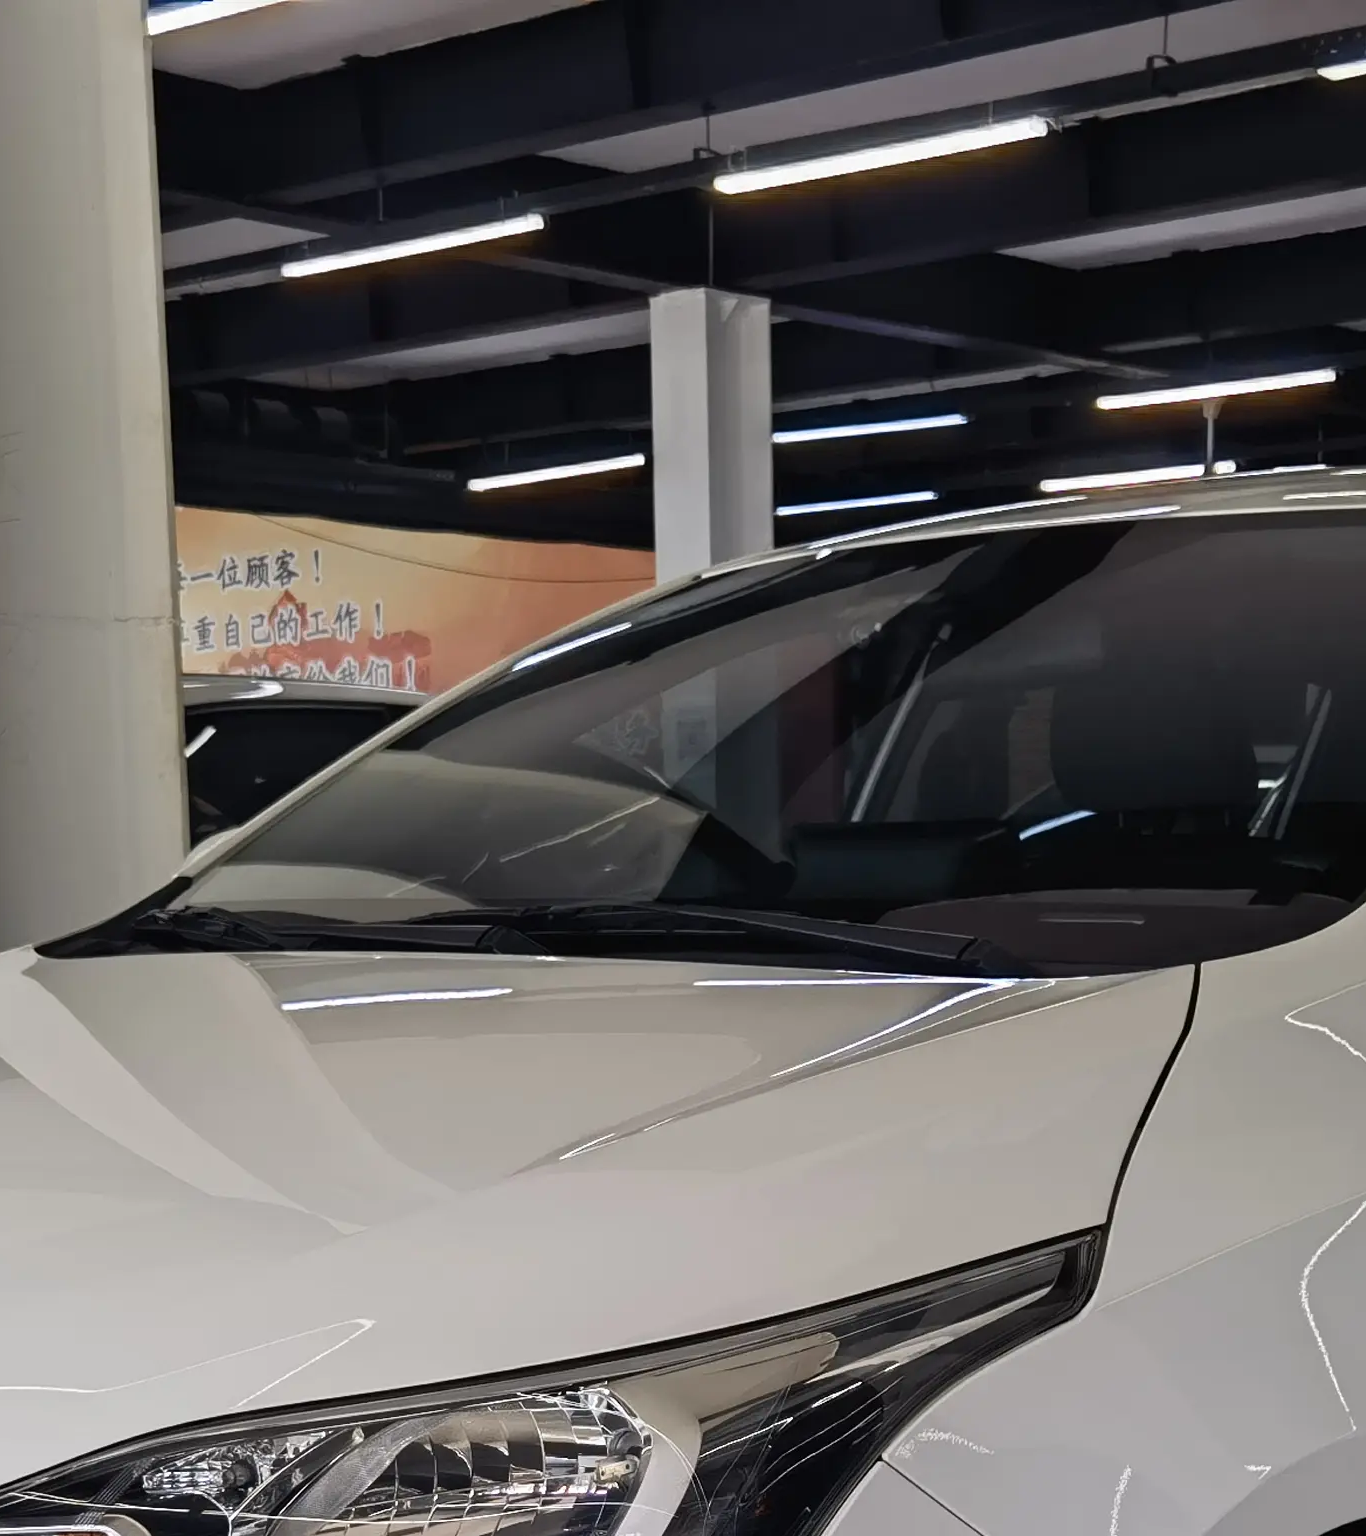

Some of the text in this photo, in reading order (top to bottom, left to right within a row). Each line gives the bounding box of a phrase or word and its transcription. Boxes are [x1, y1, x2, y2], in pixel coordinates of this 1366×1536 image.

[181, 602, 383, 652] 重自己的工作！
